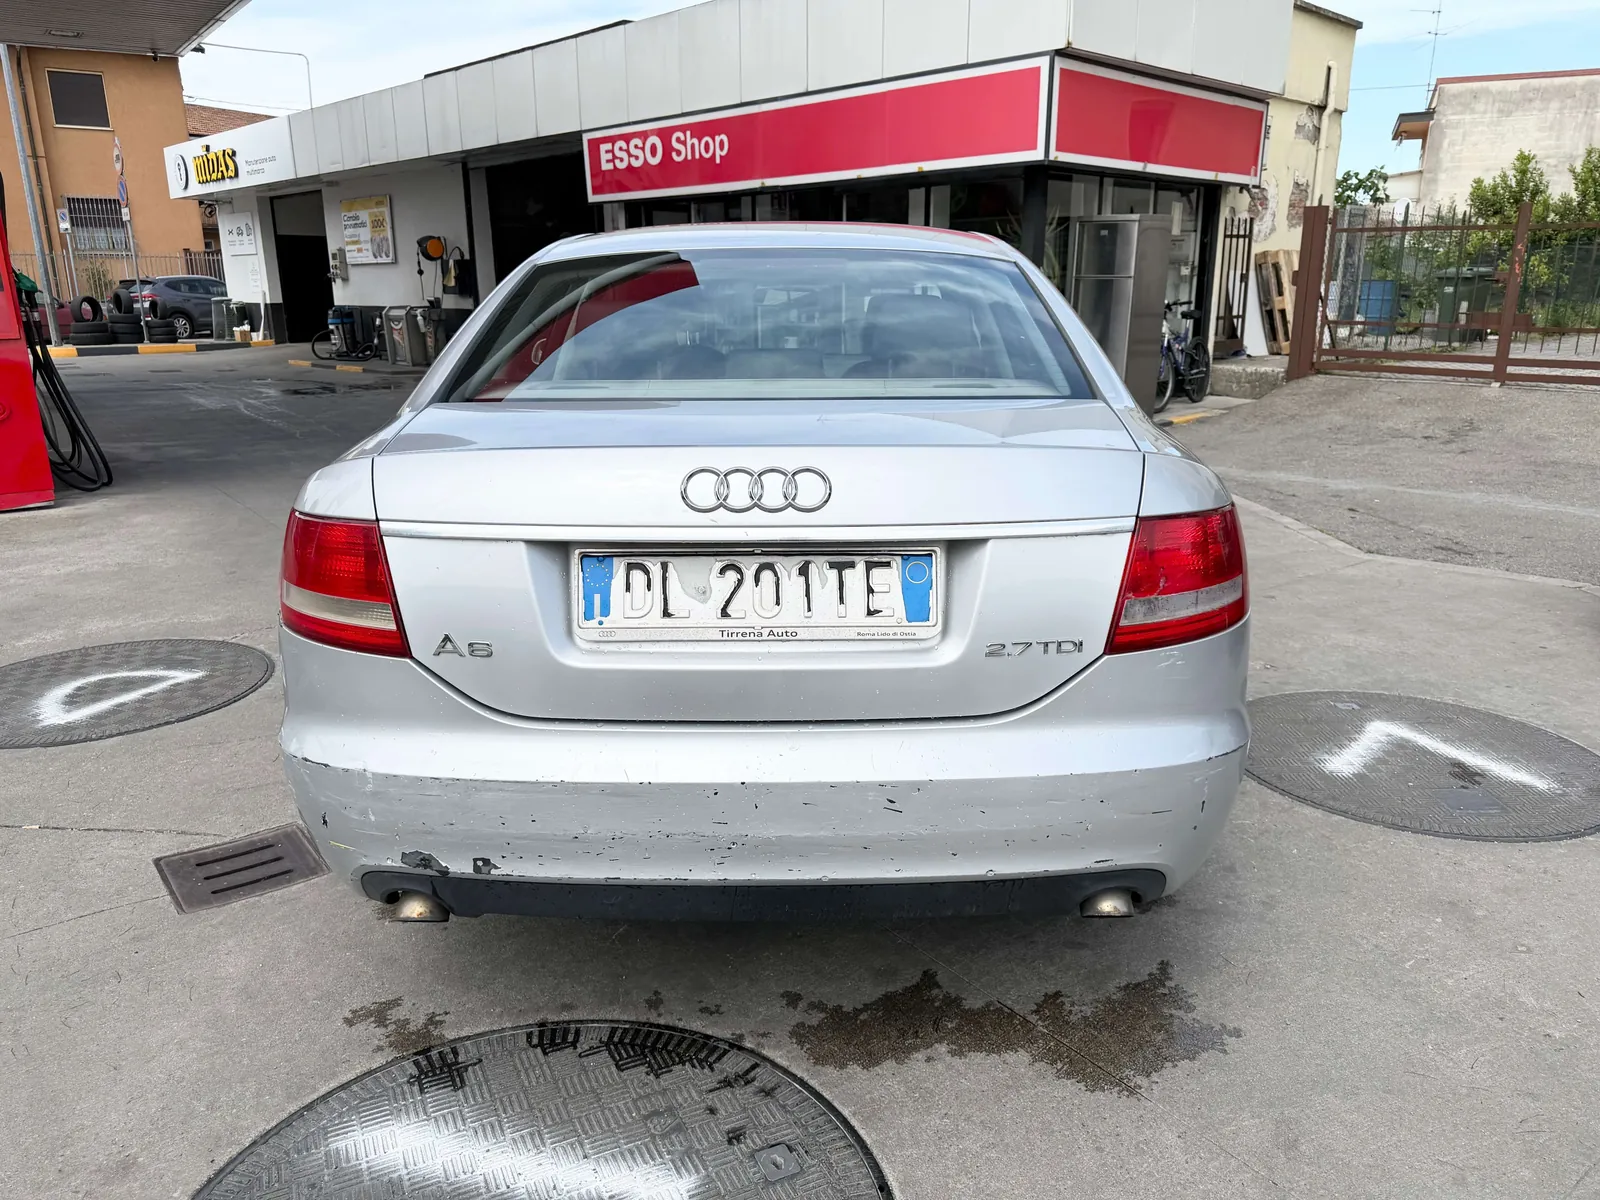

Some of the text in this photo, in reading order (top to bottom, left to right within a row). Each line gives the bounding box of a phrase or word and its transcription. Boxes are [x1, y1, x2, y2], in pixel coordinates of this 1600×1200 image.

[600, 130, 729, 171] ESSO Shop
[719, 629, 798, 638] Tirrena Auto
[433, 632, 493, 658] A6
[1036, 638, 1083, 655] TDI
